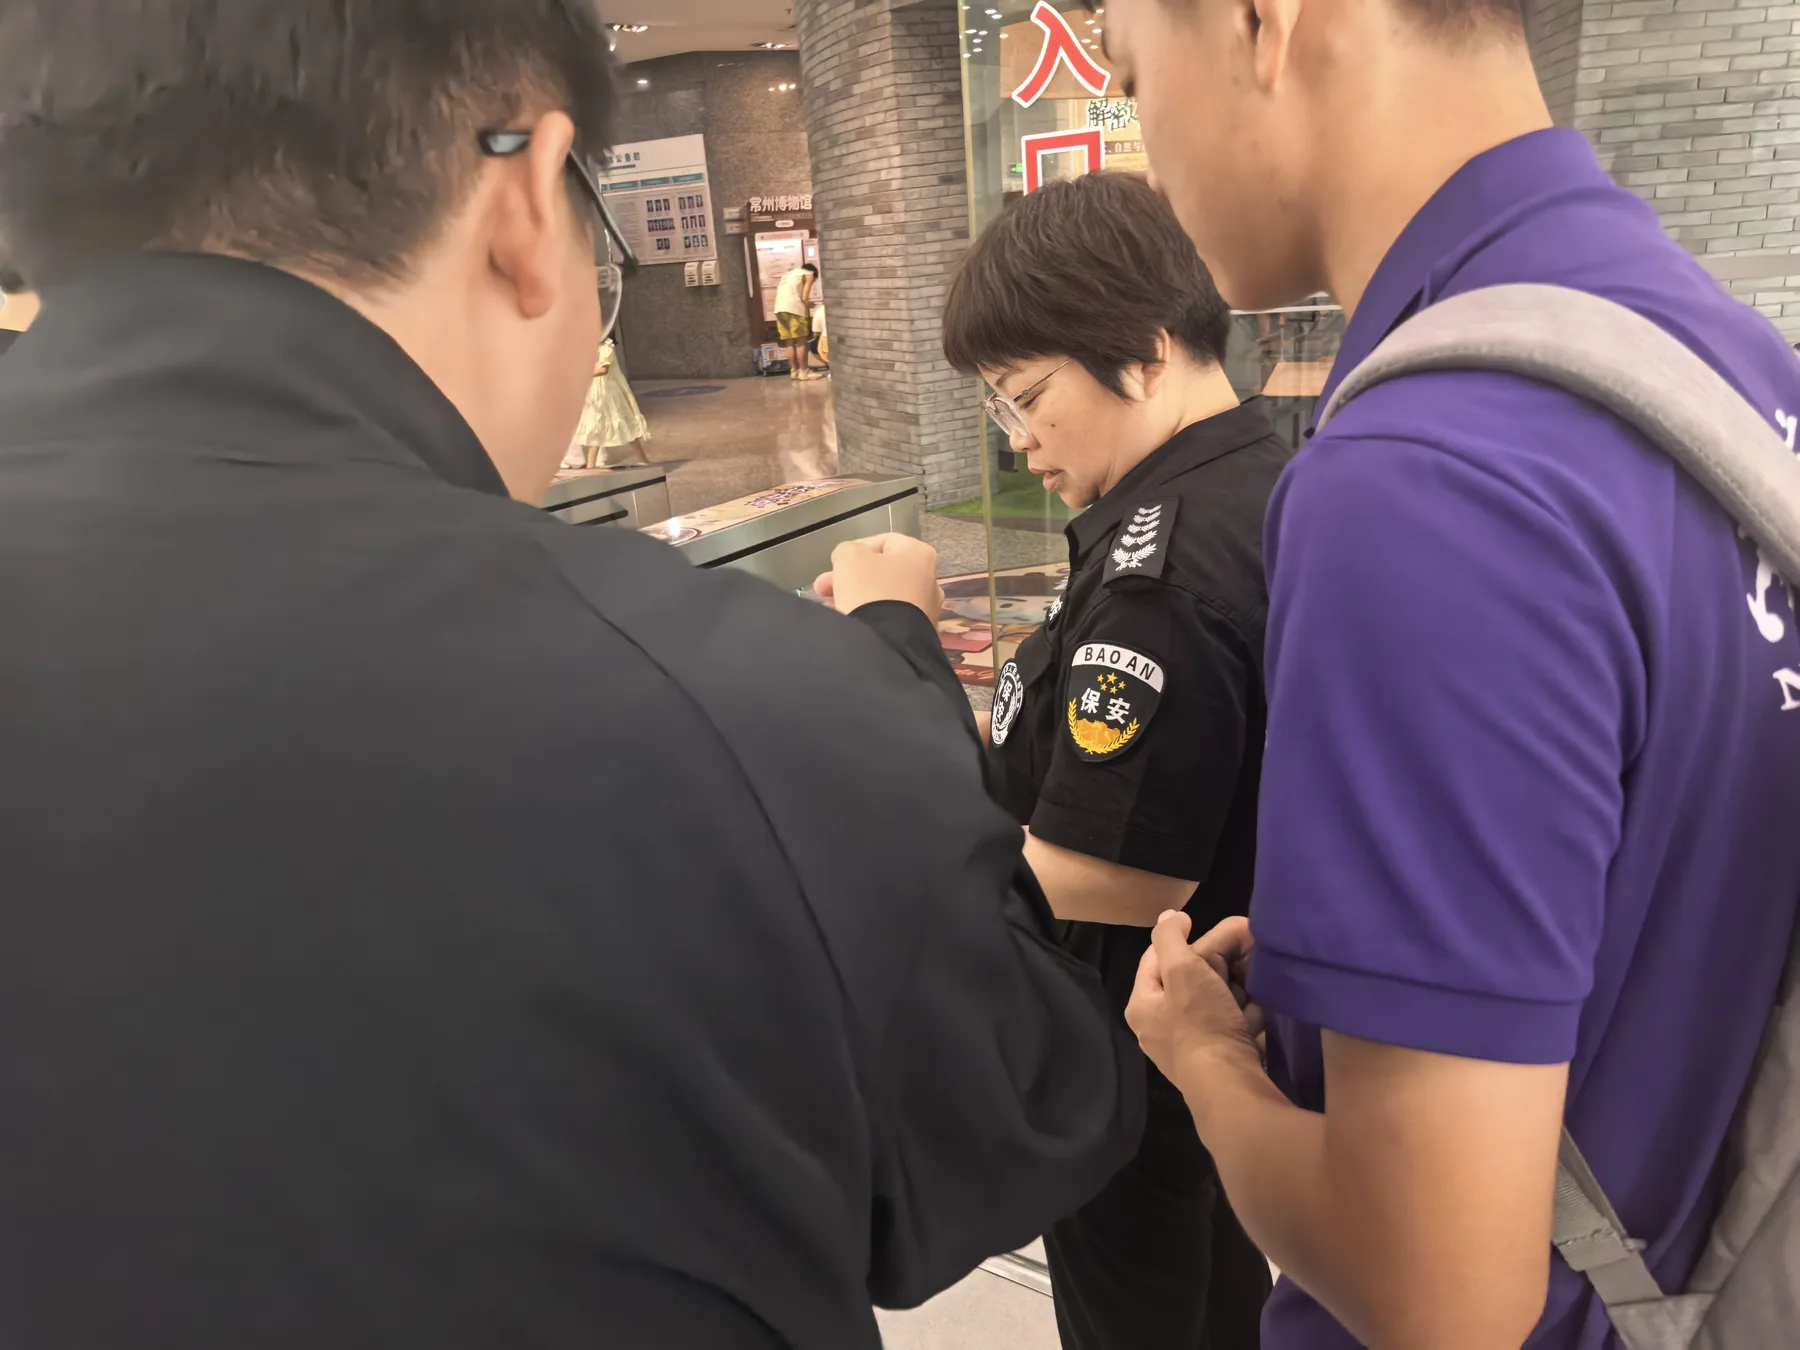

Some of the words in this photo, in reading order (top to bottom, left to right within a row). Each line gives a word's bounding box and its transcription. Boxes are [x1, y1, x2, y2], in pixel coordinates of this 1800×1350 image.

[750, 194, 812, 213] 常州博物馆
[1080, 687, 1131, 724] 保安
